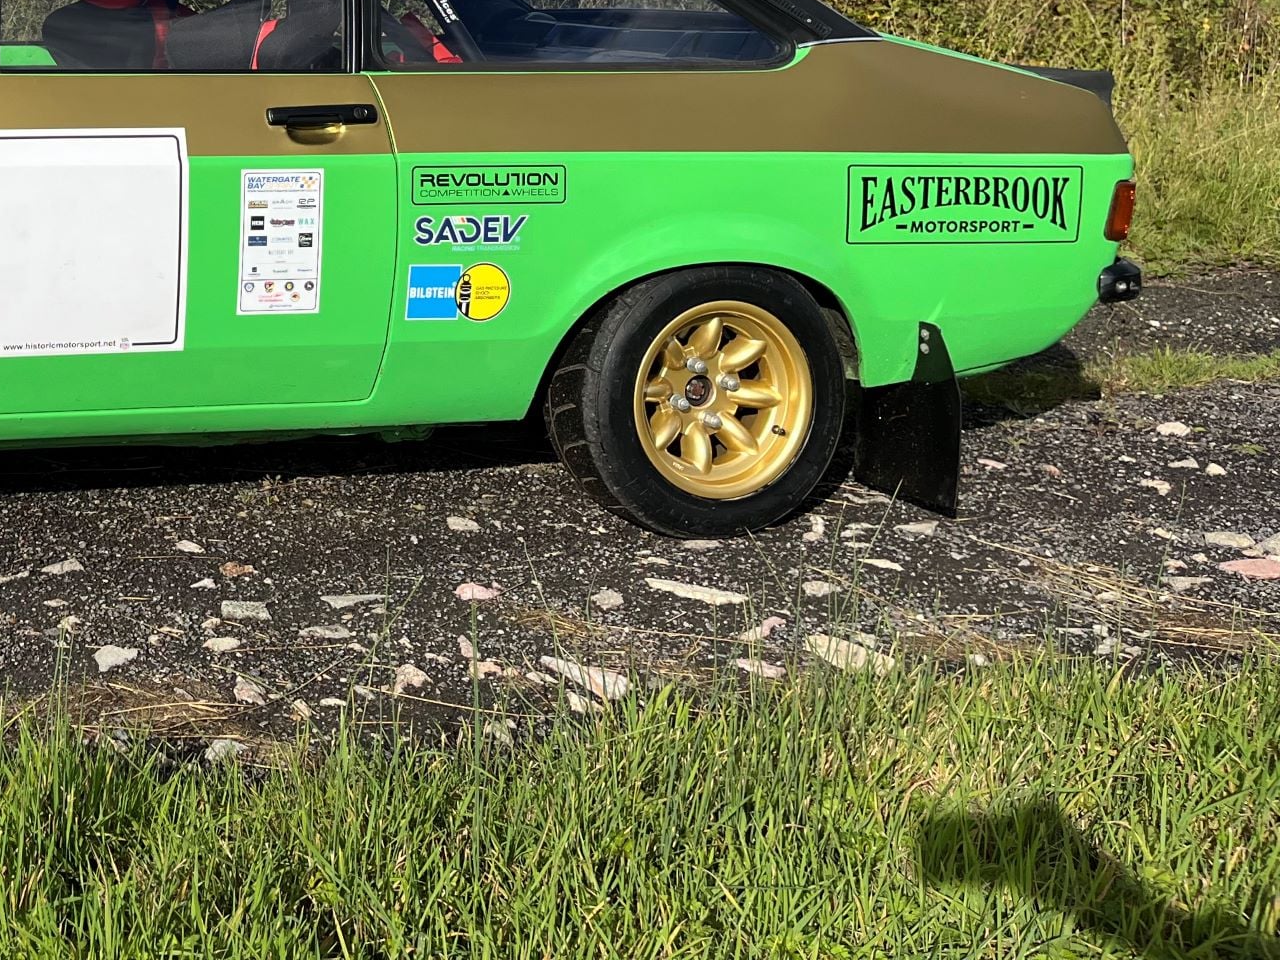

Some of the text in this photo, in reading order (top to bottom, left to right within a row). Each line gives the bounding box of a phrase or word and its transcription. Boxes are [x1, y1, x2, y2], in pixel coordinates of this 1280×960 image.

[420, 172, 559, 187] REVOLUTION
[420, 188, 559, 198] COMPETITION WHEELS
[859, 176, 1070, 232] EASTERBROOK
[414, 216, 528, 245] SADEV
[910, 220, 1021, 233] MOTORSPORT
[409, 286, 456, 299] BILSTEIN
[3, 340, 117, 352] www.historicmotorsport.net
